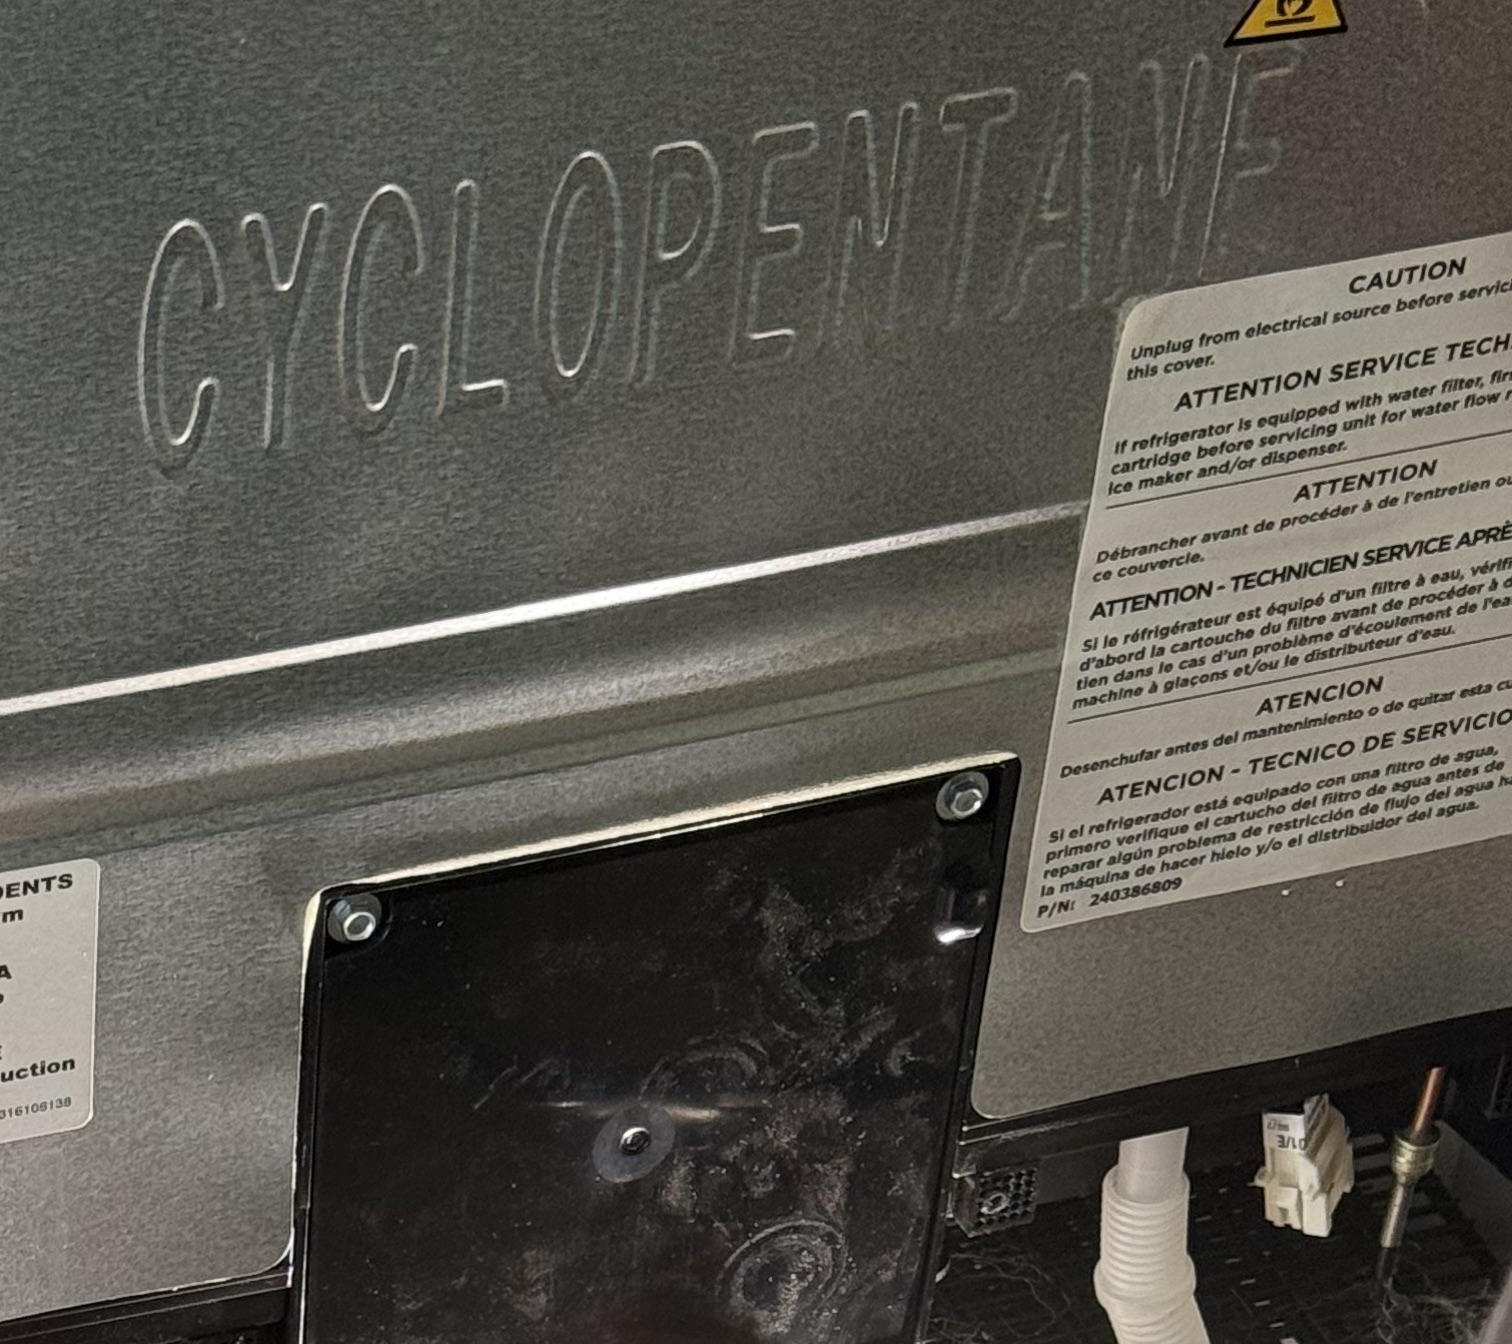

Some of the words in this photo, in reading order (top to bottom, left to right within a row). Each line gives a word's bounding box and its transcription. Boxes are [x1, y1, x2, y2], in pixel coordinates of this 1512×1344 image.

[136, 42, 1306, 475] CYCLOPENTANE
[1348, 256, 1468, 295] CAUTION
[1130, 338, 1195, 361] Unplug
[1198, 329, 1241, 349] from
[1244, 310, 1329, 339] electrical
[1331, 303, 1392, 325] source
[1395, 291, 1455, 313] before
[1126, 362, 1159, 382] this
[1162, 354, 1216, 375] cover.
[1172, 366, 1323, 413] ATTENTION
[1327, 345, 1439, 383] SERVICE
[1445, 332, 1512, 363] TECH
[1110, 449, 1193, 476] cartridge
[1195, 438, 1255, 460] before
[1257, 422, 1338, 449] servicing
[1341, 412, 1377, 433] unit
[1380, 408, 1408, 426] for
[1410, 399, 1461, 419] water
[1463, 391, 1502, 409] flow
[1113, 438, 1129, 456] If
[1130, 421, 1235, 453] refrigerator
[1236, 417, 1253, 433] is
[1256, 399, 1342, 429] equipped
[1344, 392, 1384, 413] with
[1387, 384, 1438, 405] water
[1440, 375, 1485, 395] filter,
[1107, 480, 1134, 497] ice
[1137, 469, 1195, 491] maker
[1260, 440, 1348, 468] dispenser.
[1292, 458, 1439, 504] ATTENTION
[1200, 523, 1250, 545] avant
[1252, 518, 1276, 534] de
[1376, 494, 1400, 510] de
[1088, 580, 1214, 622] ATTENTION
[1229, 551, 1360, 594] TECHNICIEN
[1361, 533, 1455, 567] SERVICE
[1091, 569, 1114, 583] ce
[1116, 550, 1206, 579] couvercle.
[1075, 675, 1110, 692] tien
[1112, 665, 1154, 684] dans
[1157, 660, 1175, 675] le
[1177, 655, 1207, 671] cas
[1455, 600, 1479, 616] de
[1481, 595, 1512, 611] l'ea
[1080, 636, 1099, 653] Si
[1102, 634, 1119, 650] le
[1235, 605, 1263, 623] est
[1370, 578, 1412, 597] filtre
[1429, 568, 1466, 585] eau,
[1071, 686, 1145, 711] machine
[1281, 653, 1300, 669] le
[1303, 634, 1404, 664] distributeur
[1254, 675, 1385, 717] ATENCION
[1059, 747, 1162, 779] Desenchufar
[1163, 739, 1210, 758] antes
[1212, 730, 1240, 748] del
[1241, 708, 1365, 743] mantenimiento
[1367, 705, 1380, 717] o
[1382, 699, 1405, 714] de
[1407, 689, 1457, 711] quitar
[1458, 683, 1494, 699] esta
[1095, 764, 1226, 806] ATENCION
[1247, 739, 1356, 776] TECNICO
[1361, 730, 1397, 754] DE
[1400, 707, 1512, 746] SERVICIO
[1047, 828, 1066, 844] Si
[1067, 823, 1086, 840] el
[1087, 805, 1191, 836] refrigerador
[1231, 780, 1312, 807] equipado
[1315, 774, 1347, 791] con
[1349, 768, 1382, 784] una
[1384, 759, 1426, 777] filtro
[1428, 753, 1451, 769] de
[1453, 745, 1500, 764] agua,
[1039, 884, 1056, 898] la
[1133, 863, 1157, 878] de
[1159, 854, 1207, 874] hacer
[1209, 844, 1252, 863] hielo
[1287, 832, 1304, 849] el
[1306, 815, 1404, 845] distribuidor
[1405, 806, 1434, 824] del
[1434, 800, 1480, 819] agua.
